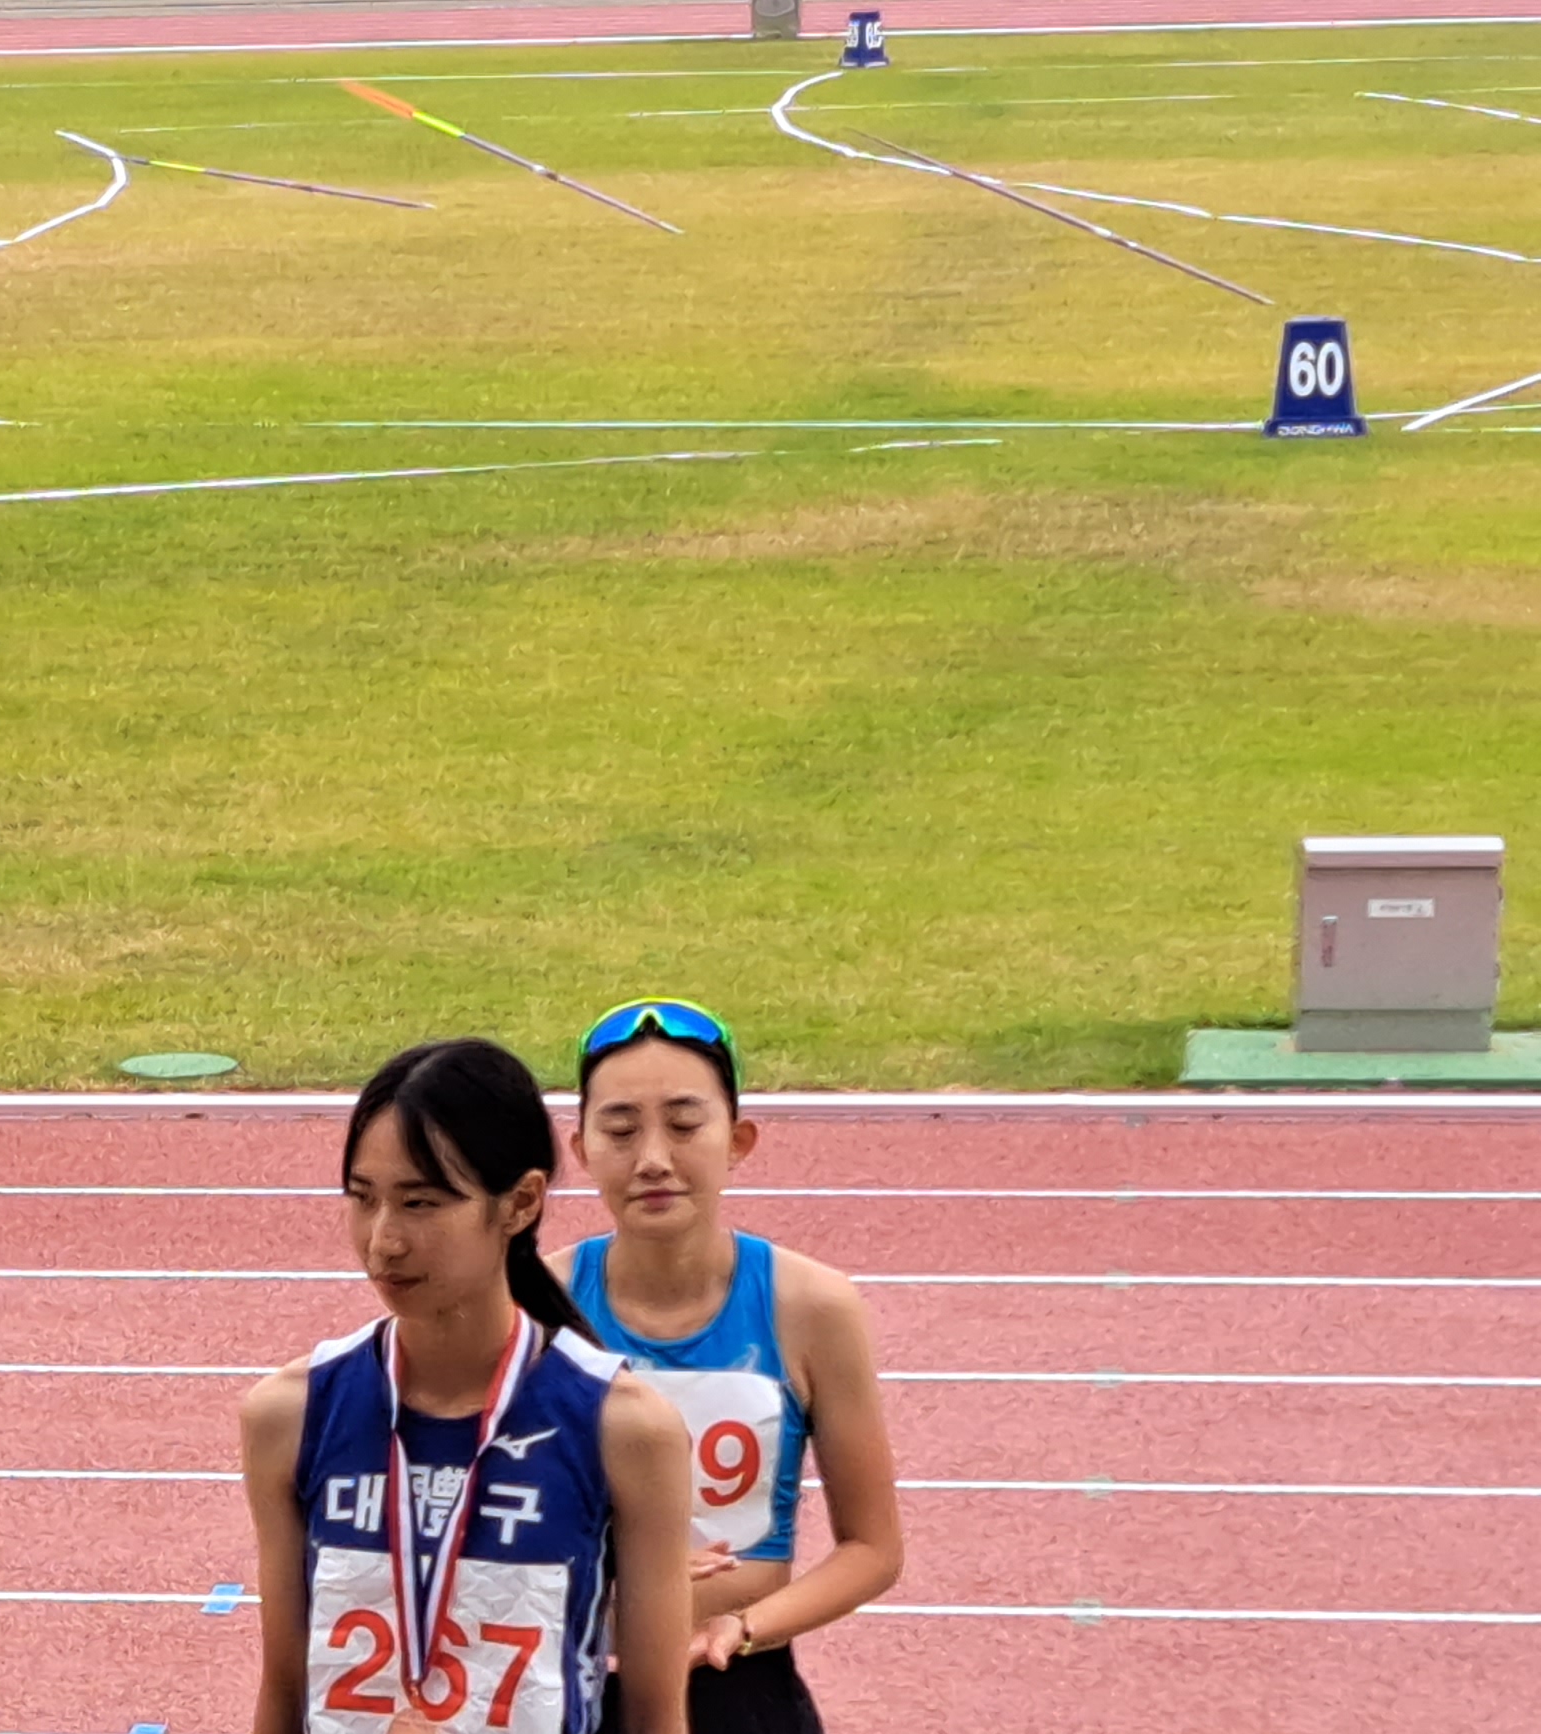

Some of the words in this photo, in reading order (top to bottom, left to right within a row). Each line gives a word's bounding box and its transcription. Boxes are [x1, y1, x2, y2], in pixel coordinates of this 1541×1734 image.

[1289, 341, 1345, 397] 60
[688, 1420, 761, 1507] 9
[325, 1609, 543, 1729] 267
